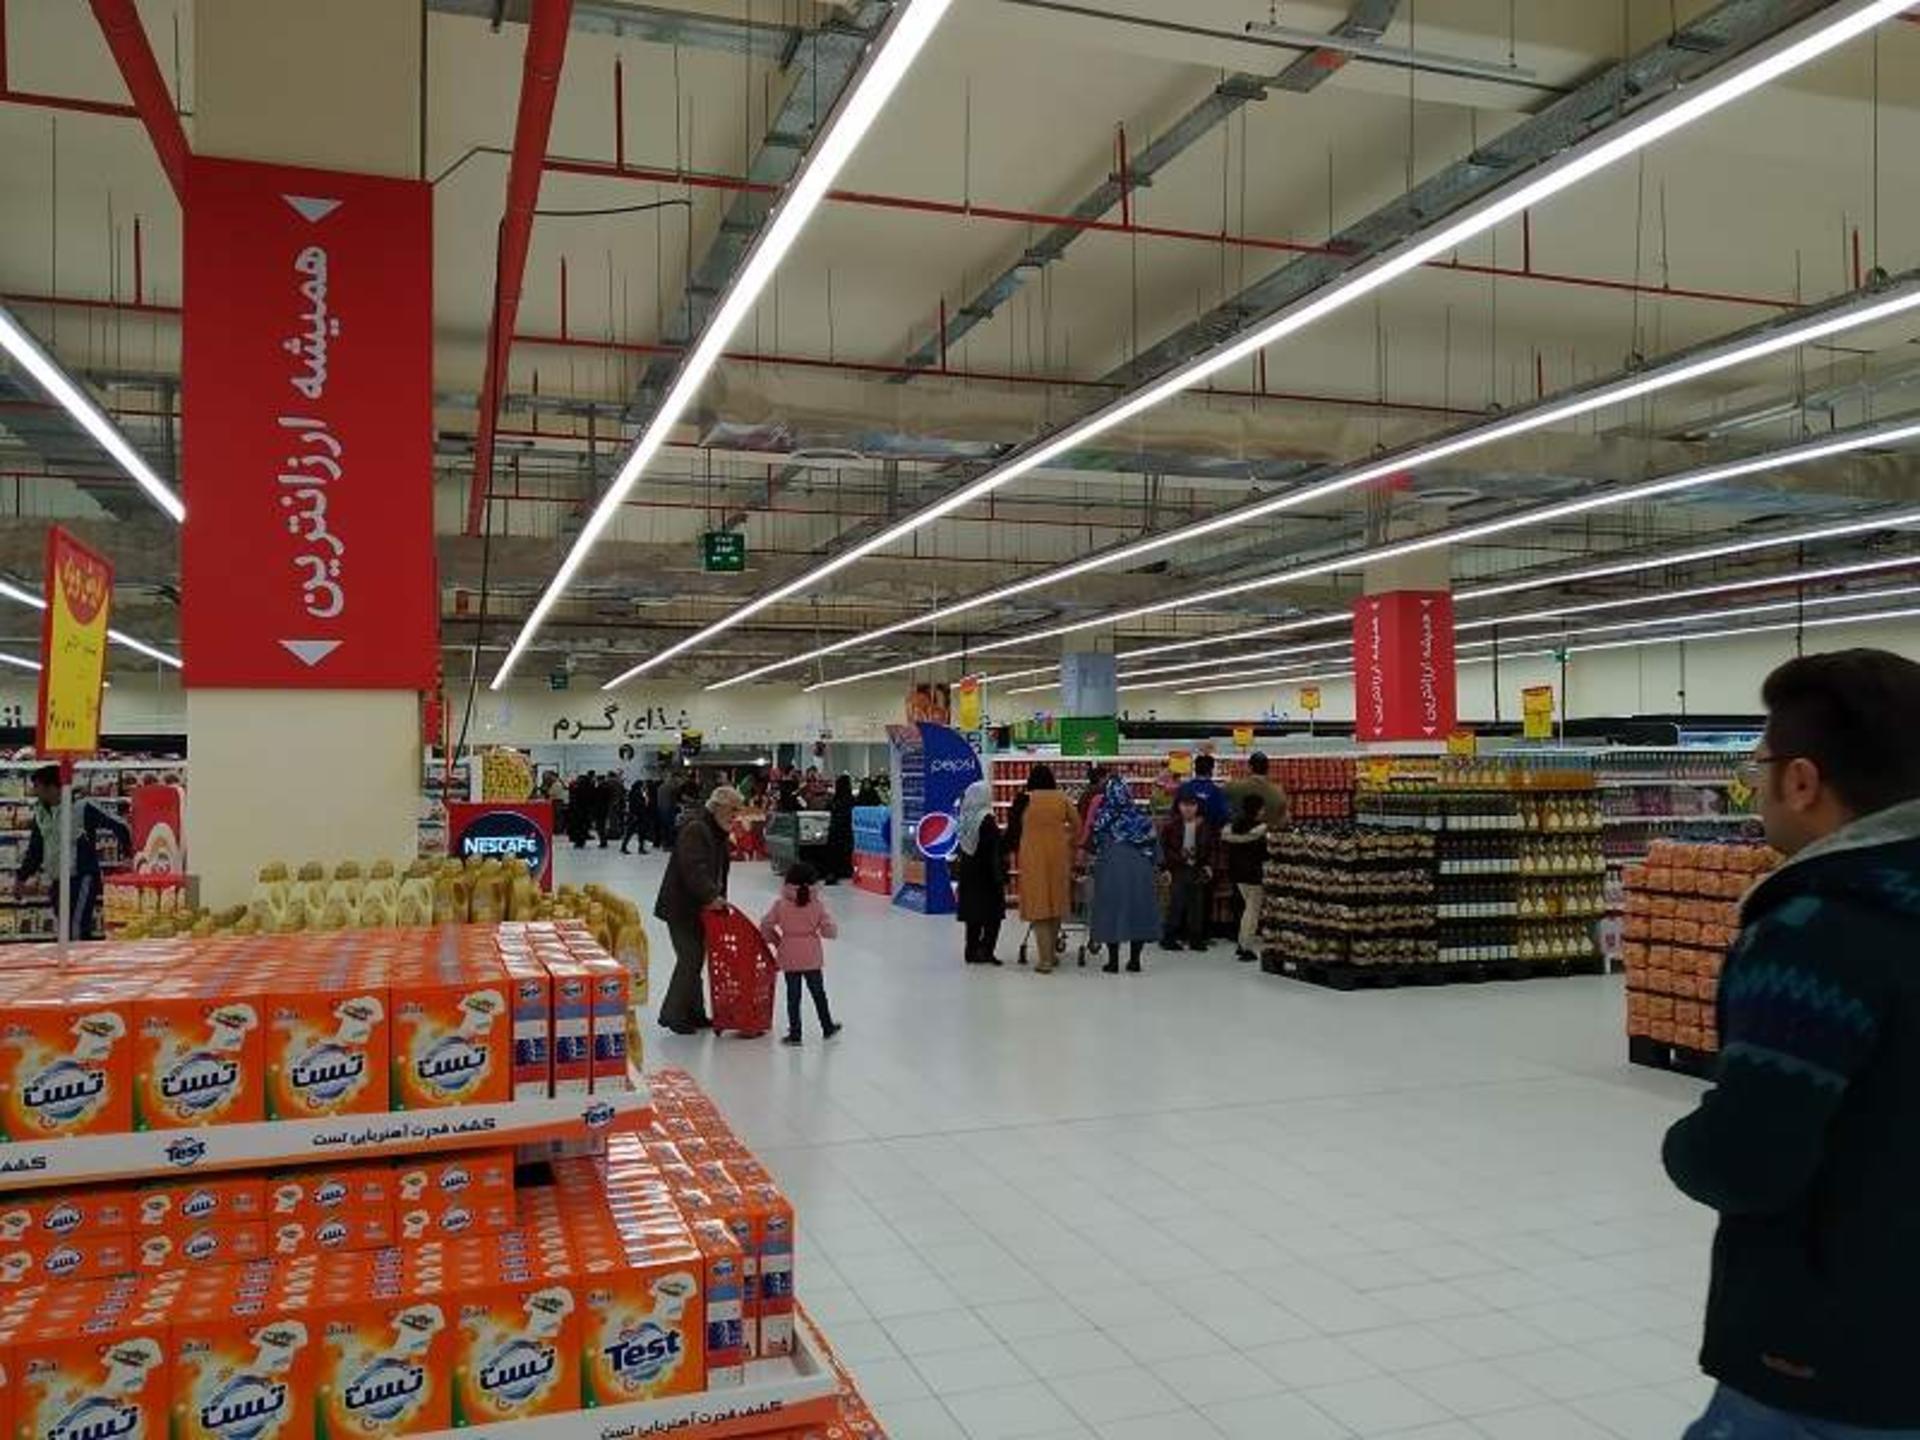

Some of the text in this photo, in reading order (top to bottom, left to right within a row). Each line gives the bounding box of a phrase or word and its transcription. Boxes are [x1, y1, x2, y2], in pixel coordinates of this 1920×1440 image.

[277, 246, 345, 618] همیشه ارزانترین
[553, 702, 620, 740] گرم
[930, 756, 977, 774] pepsi
[162, 1062, 238, 1097] تست
[292, 1054, 364, 1088] تست
[417, 1045, 487, 1079] تست
[23, 1071, 105, 1107] تست
[582, 1106, 615, 1125] Test
[164, 1139, 206, 1162] Test
[312, 1132, 348, 1146] تست
[603, 1329, 682, 1372] Test
[479, 1347, 555, 1390] تست
[345, 1367, 424, 1410] تست
[201, 1384, 286, 1429] تست
